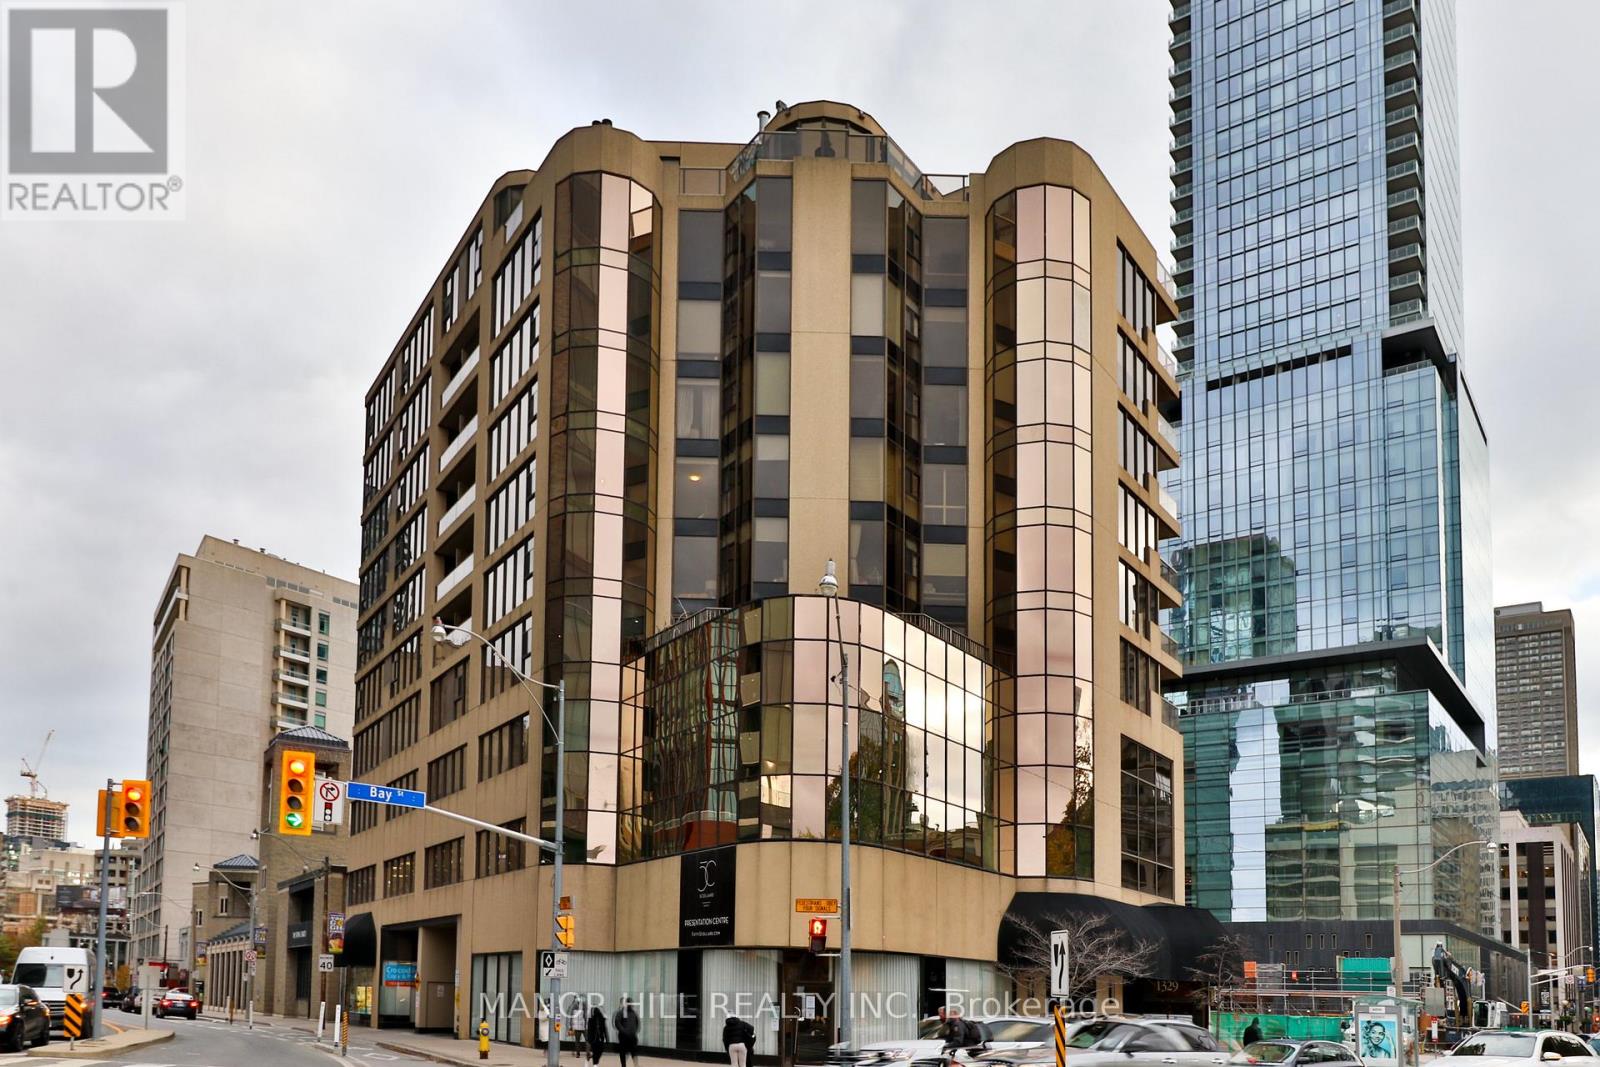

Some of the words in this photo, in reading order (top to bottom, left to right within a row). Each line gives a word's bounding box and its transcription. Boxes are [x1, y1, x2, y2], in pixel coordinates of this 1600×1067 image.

[369, 786, 392, 801] Bay
[684, 918, 712, 927] PRESENTATION
[712, 916, 729, 925] CENTRE
[320, 962, 332, 970] 40
[1157, 980, 1179, 992] 1329
